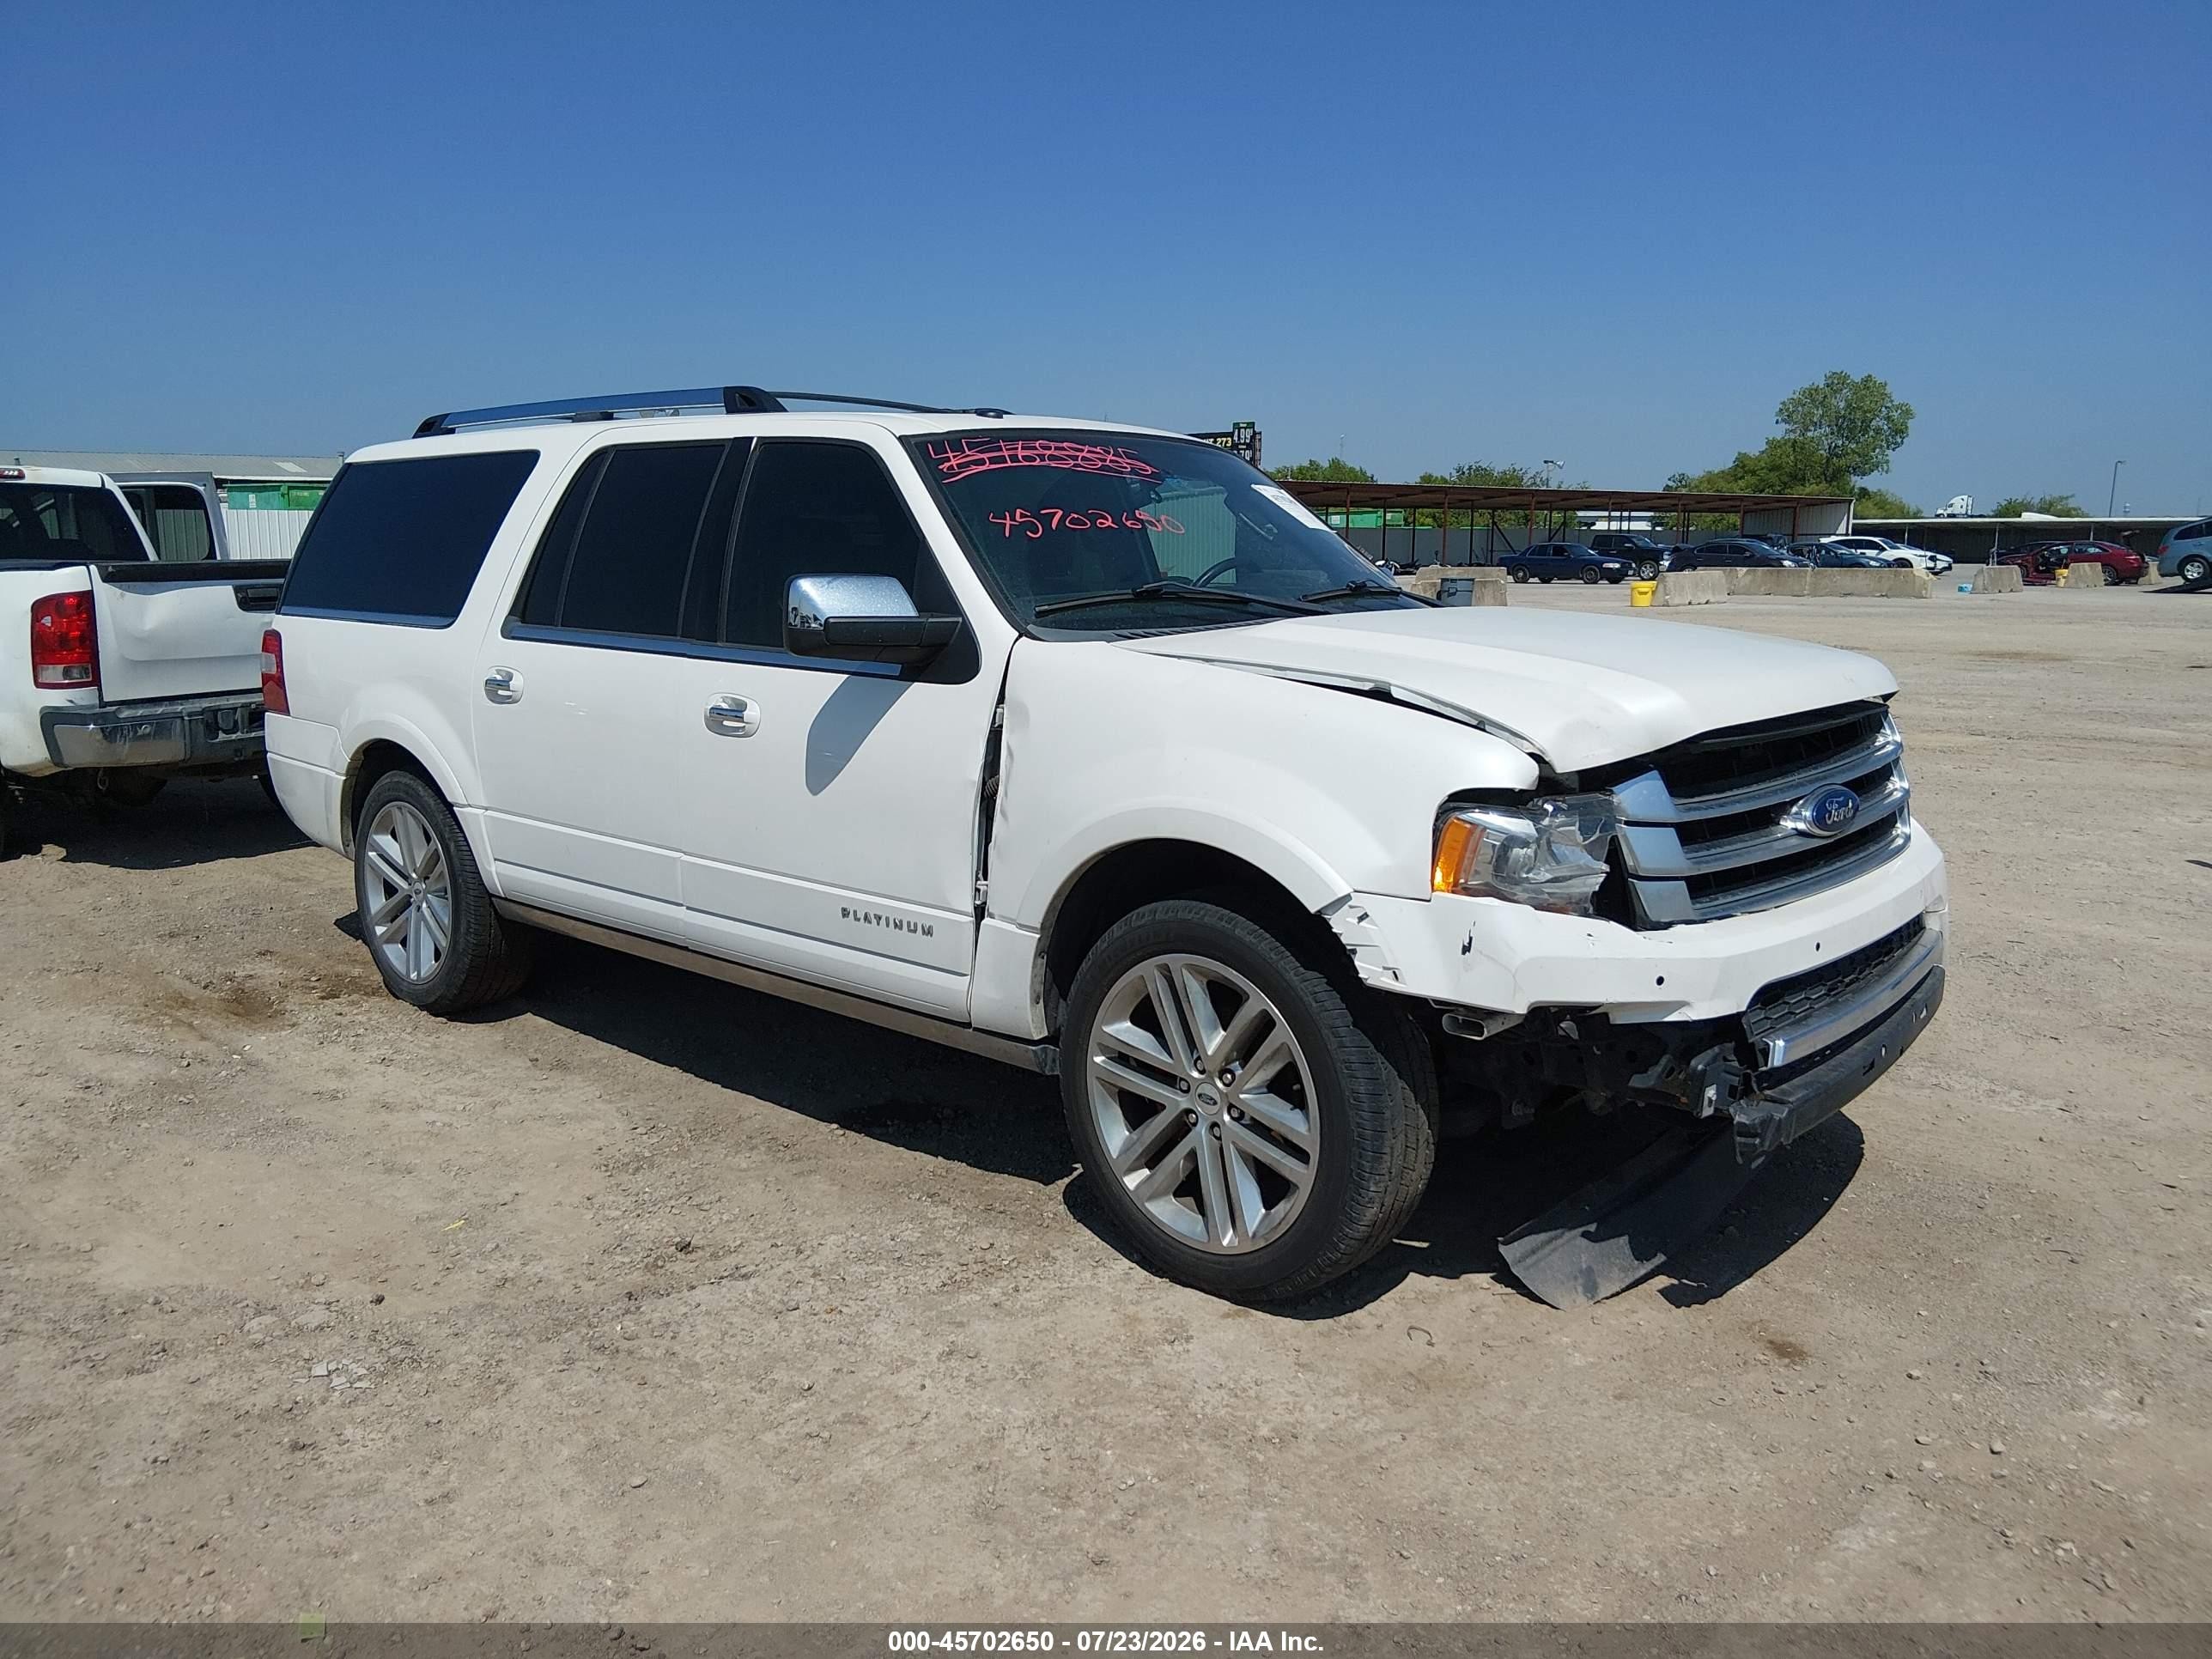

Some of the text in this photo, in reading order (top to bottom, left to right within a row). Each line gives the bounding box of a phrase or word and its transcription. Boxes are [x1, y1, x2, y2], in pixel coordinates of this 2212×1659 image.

[1216, 437, 1232, 447] 273
[988, 508, 1185, 538] 45702650
[1826, 796, 1854, 824] Ford
[841, 907, 933, 938] PLATINUM
